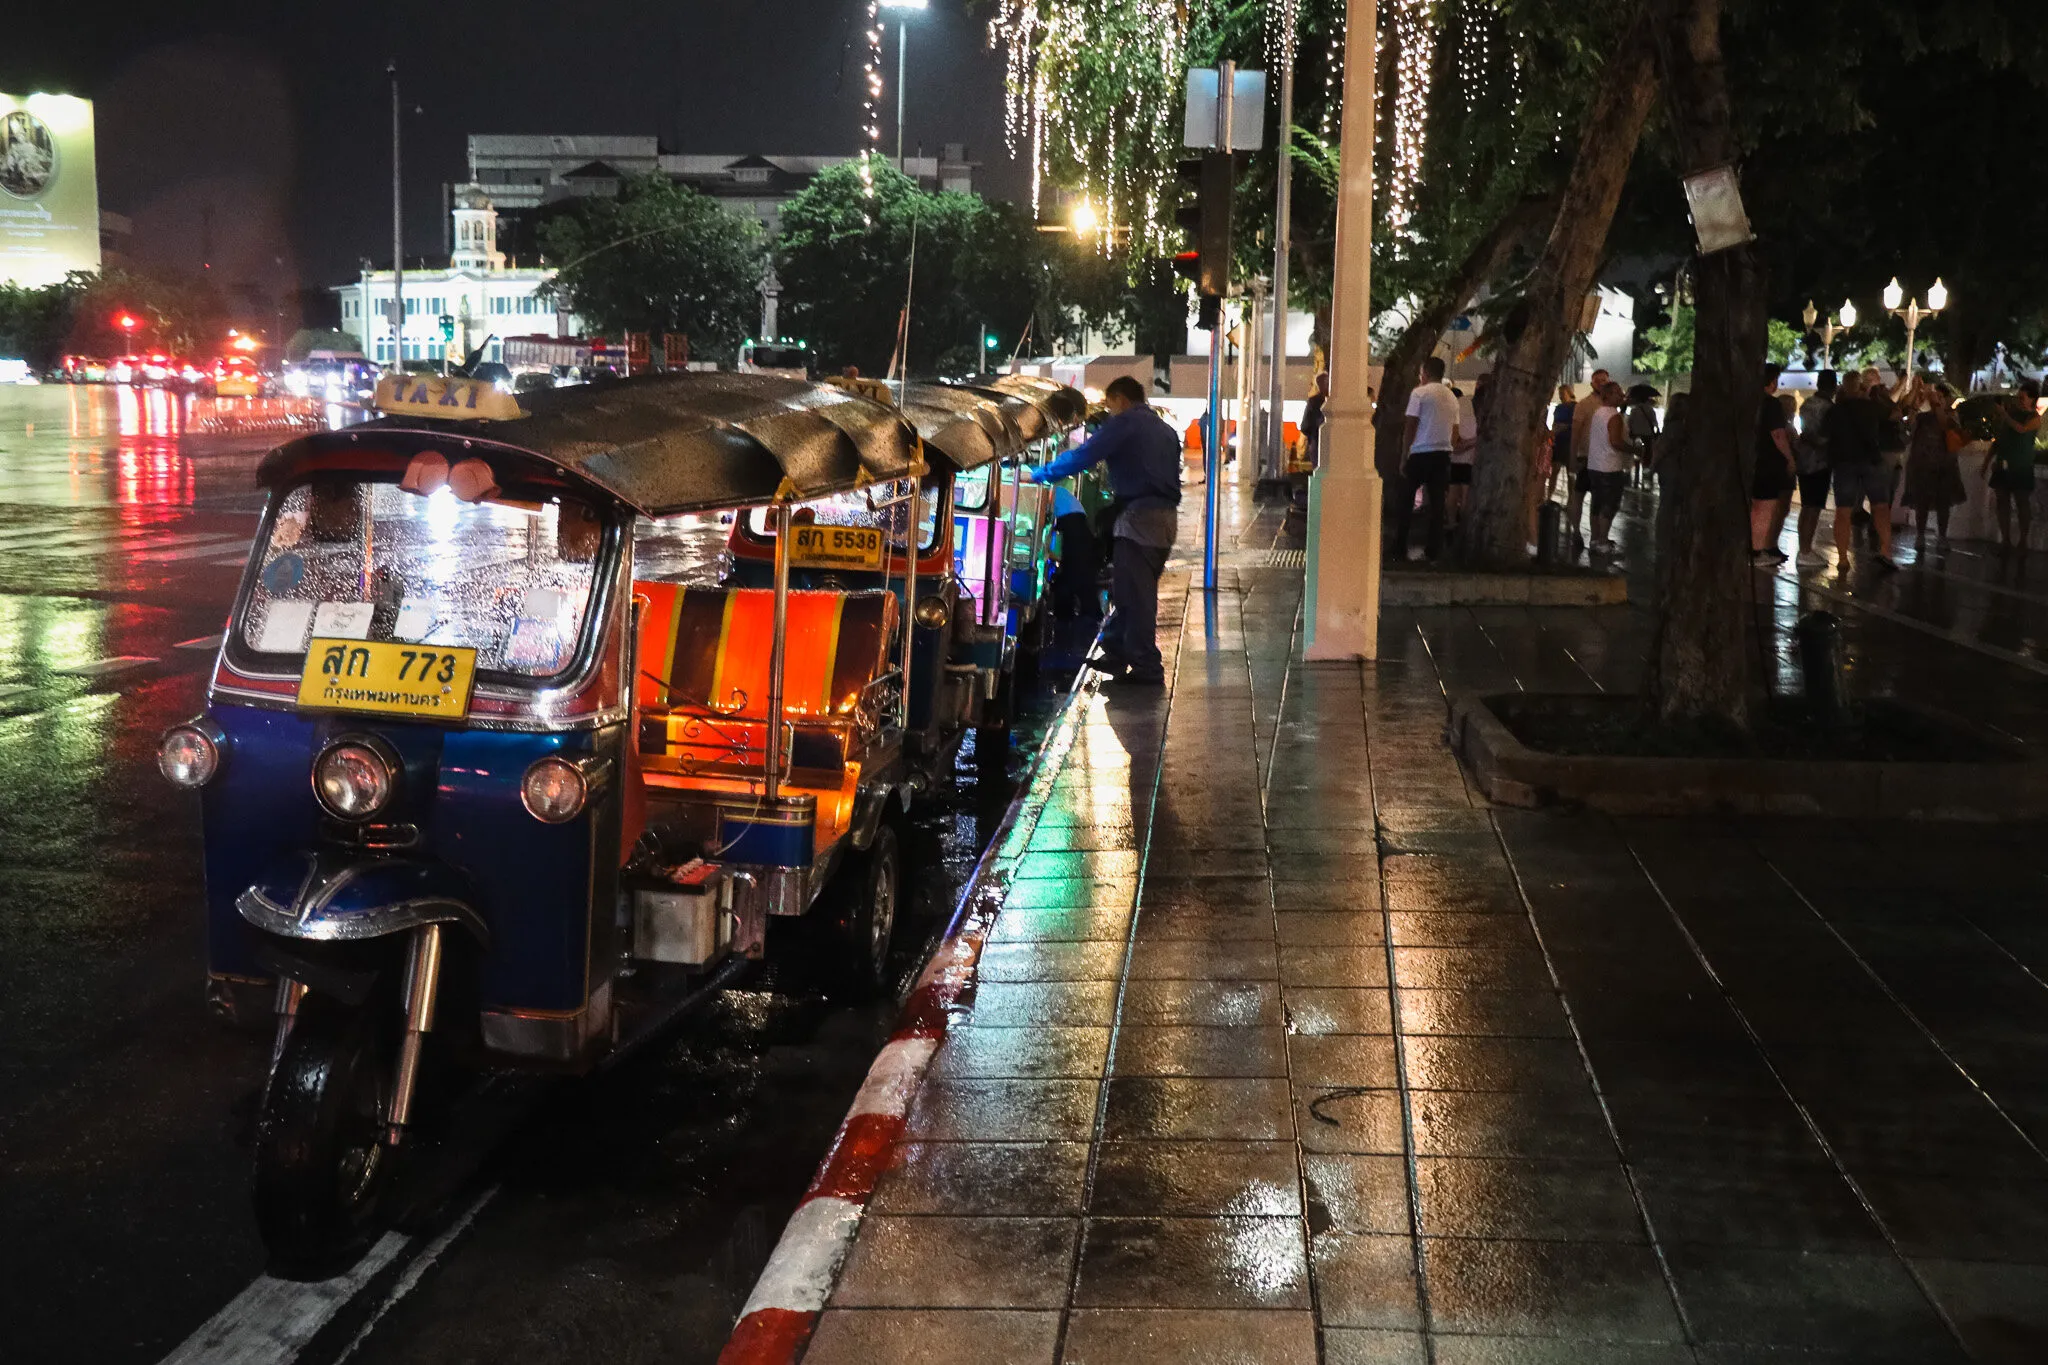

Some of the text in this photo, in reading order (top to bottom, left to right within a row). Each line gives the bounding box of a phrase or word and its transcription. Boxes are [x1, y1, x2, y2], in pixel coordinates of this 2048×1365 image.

[392, 378, 478, 408] TAXI
[833, 531, 877, 550] 5538
[322, 644, 457, 684] สก 773
[323, 685, 441, 706] กรุงเทพมหานคร
